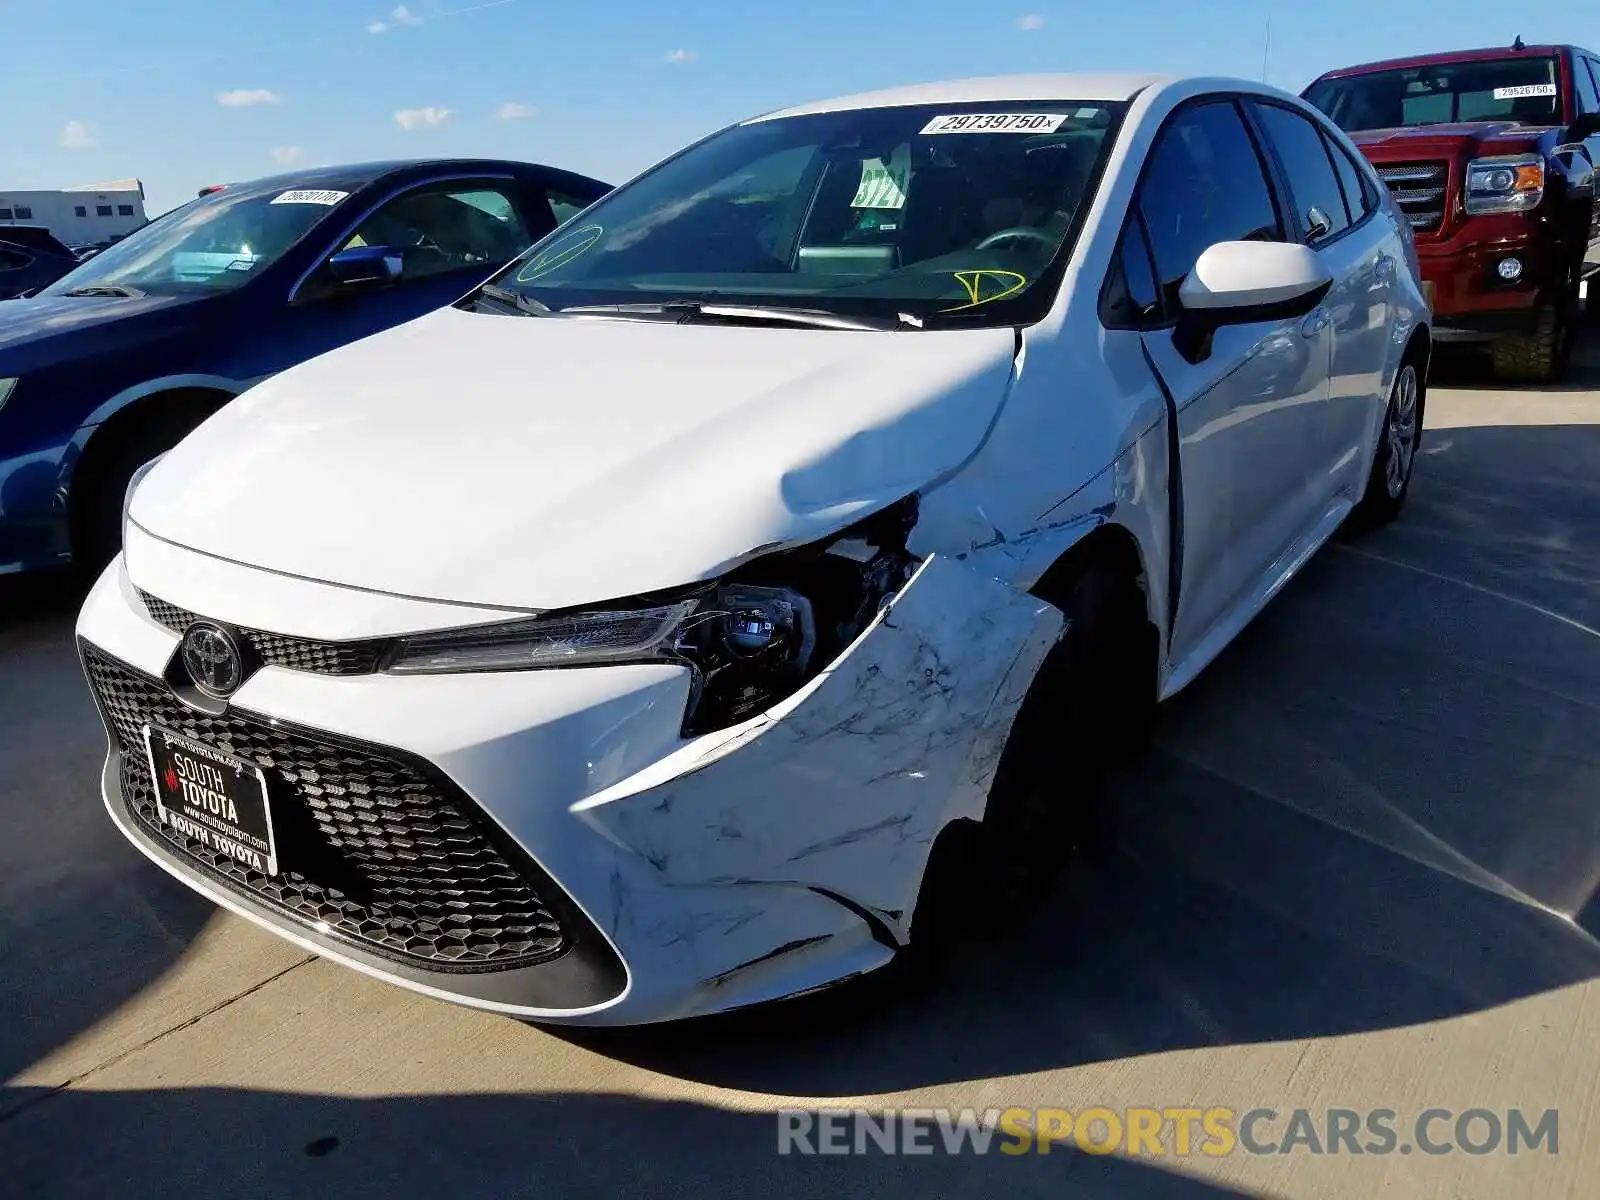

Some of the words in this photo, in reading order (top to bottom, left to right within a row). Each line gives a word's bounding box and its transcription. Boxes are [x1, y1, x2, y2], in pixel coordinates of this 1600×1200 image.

[174, 752, 225, 794] SOUTH
[179, 778, 239, 825] TOYOTA
[170, 813, 209, 844] SOUTH
[212, 833, 262, 870] TOYOTA
[183, 804, 268, 852] www.southtoyotapm.com
